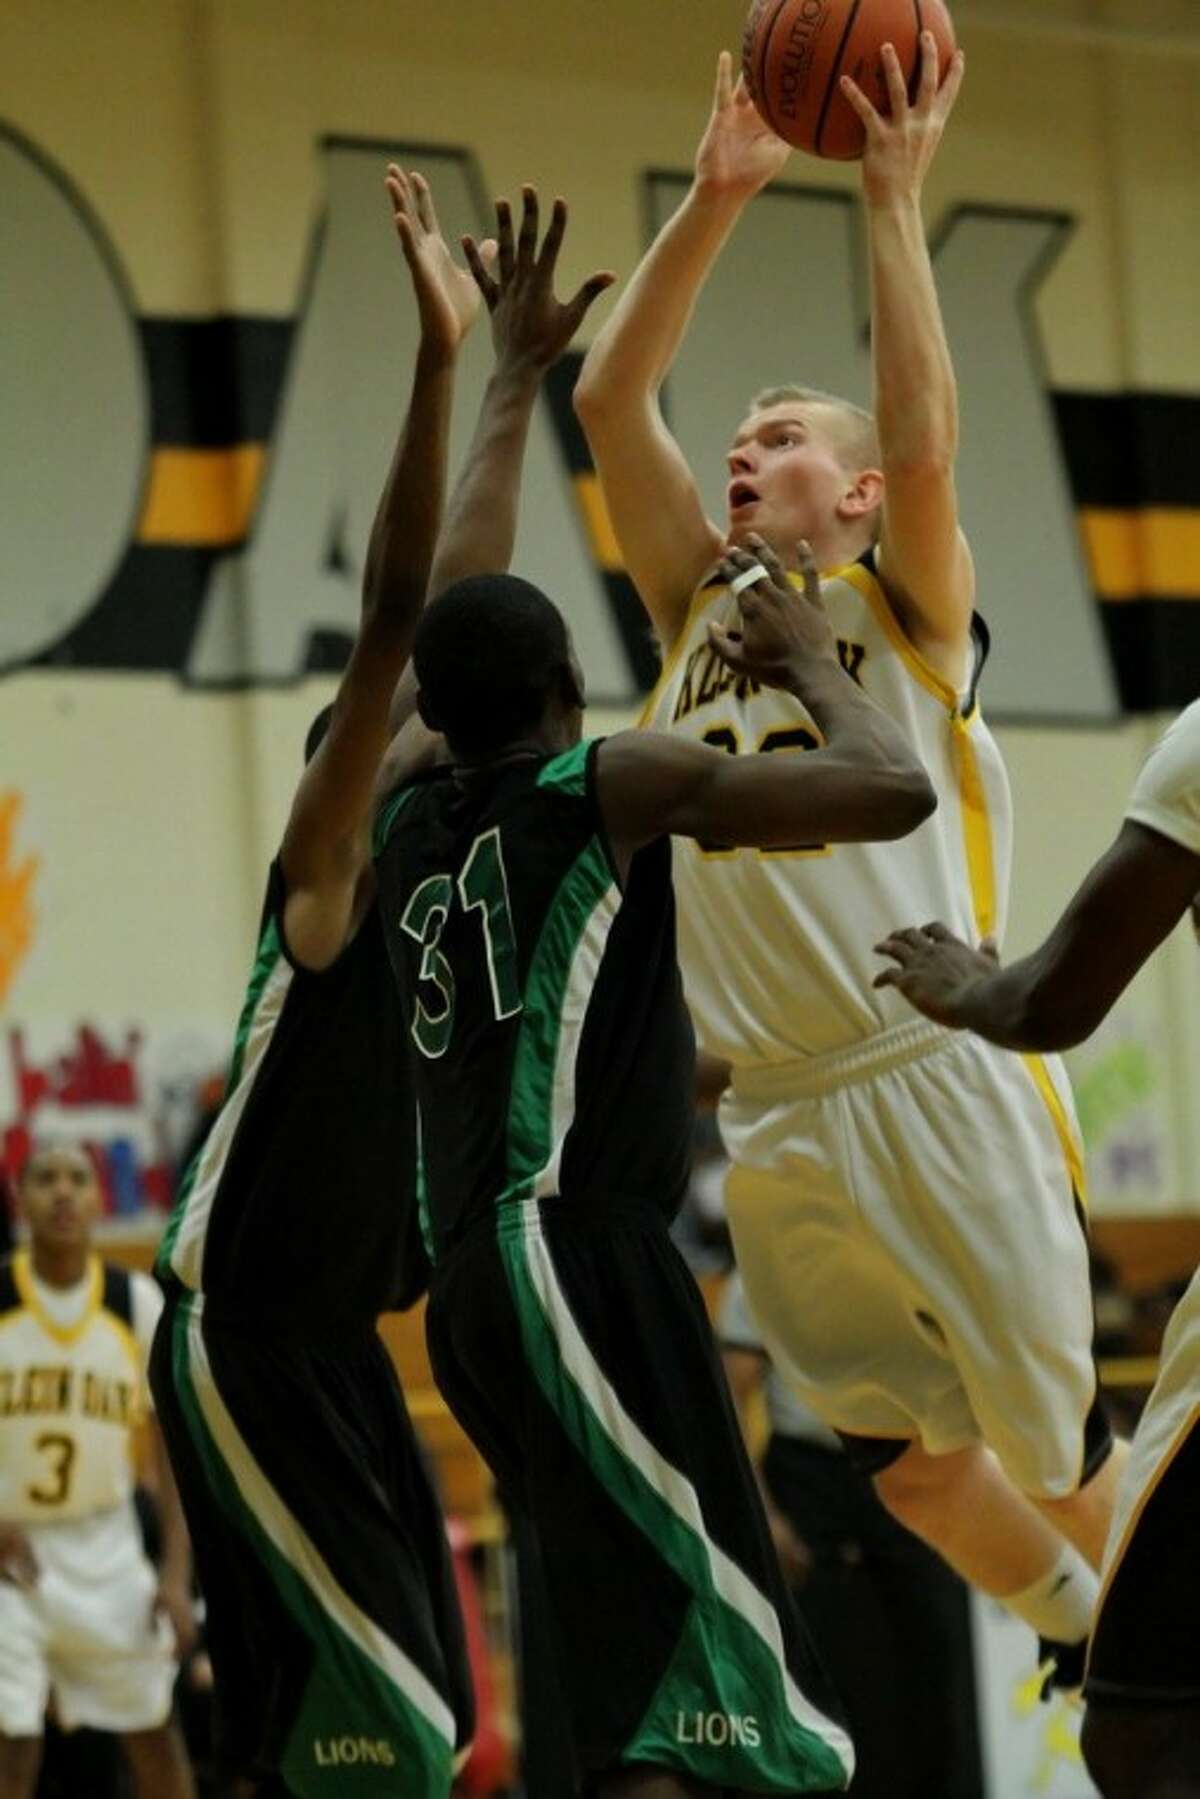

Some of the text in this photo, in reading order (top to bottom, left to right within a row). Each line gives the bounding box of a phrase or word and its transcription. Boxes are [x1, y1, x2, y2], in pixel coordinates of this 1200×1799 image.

[778, 0, 824, 120] EVOLUTIO
[400, 826, 524, 1059] 31
[28, 1430, 75, 1505] 3
[313, 1735, 396, 1767] LIONS
[677, 1708, 761, 1748] LIONS
